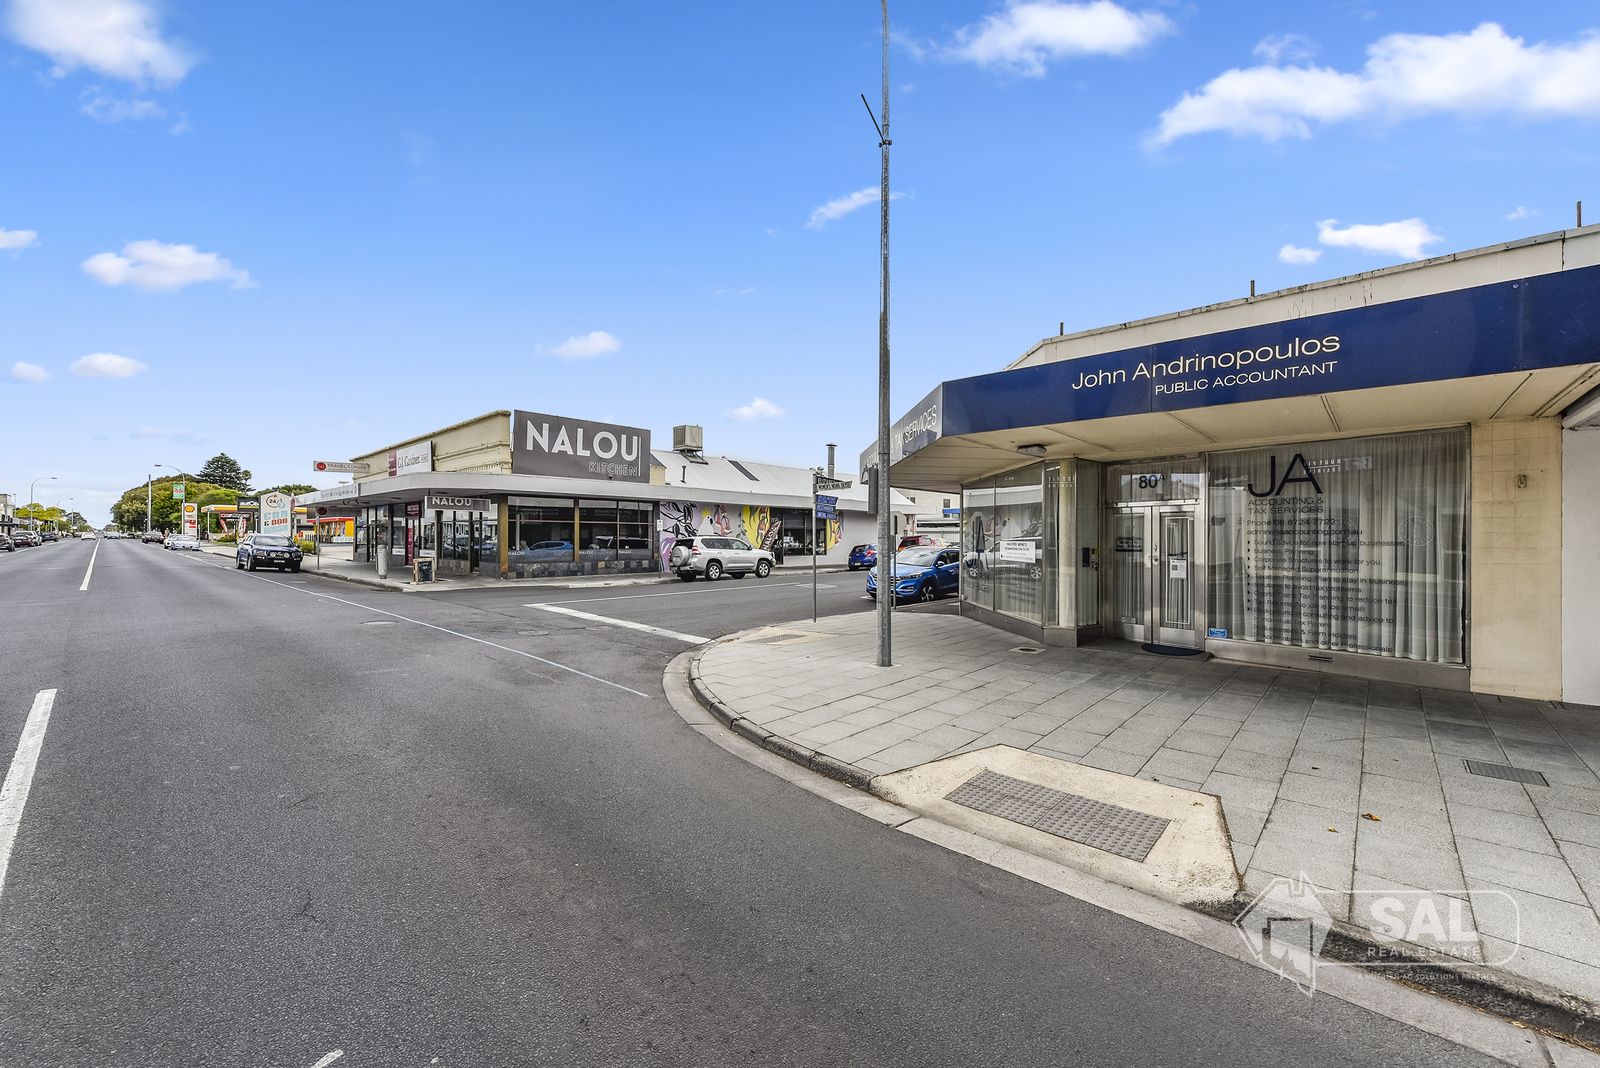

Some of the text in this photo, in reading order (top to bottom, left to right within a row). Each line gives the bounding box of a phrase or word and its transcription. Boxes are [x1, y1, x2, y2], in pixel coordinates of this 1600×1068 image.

[1072, 335, 1341, 391] John Andrinopoulos
[1155, 360, 1338, 396] PUBLIC ACCOUNTANT
[904, 404, 937, 444] SERVICES
[526, 419, 638, 462] NALOU
[588, 461, 638, 477] KITCHEN
[1247, 453, 1324, 498] JA
[432, 496, 472, 506] NALOU
[1247, 496, 1325, 507] ACCOUNTING &
[1248, 505, 1324, 515] TAX SERVICES
[1246, 519, 1272, 527] Phone
